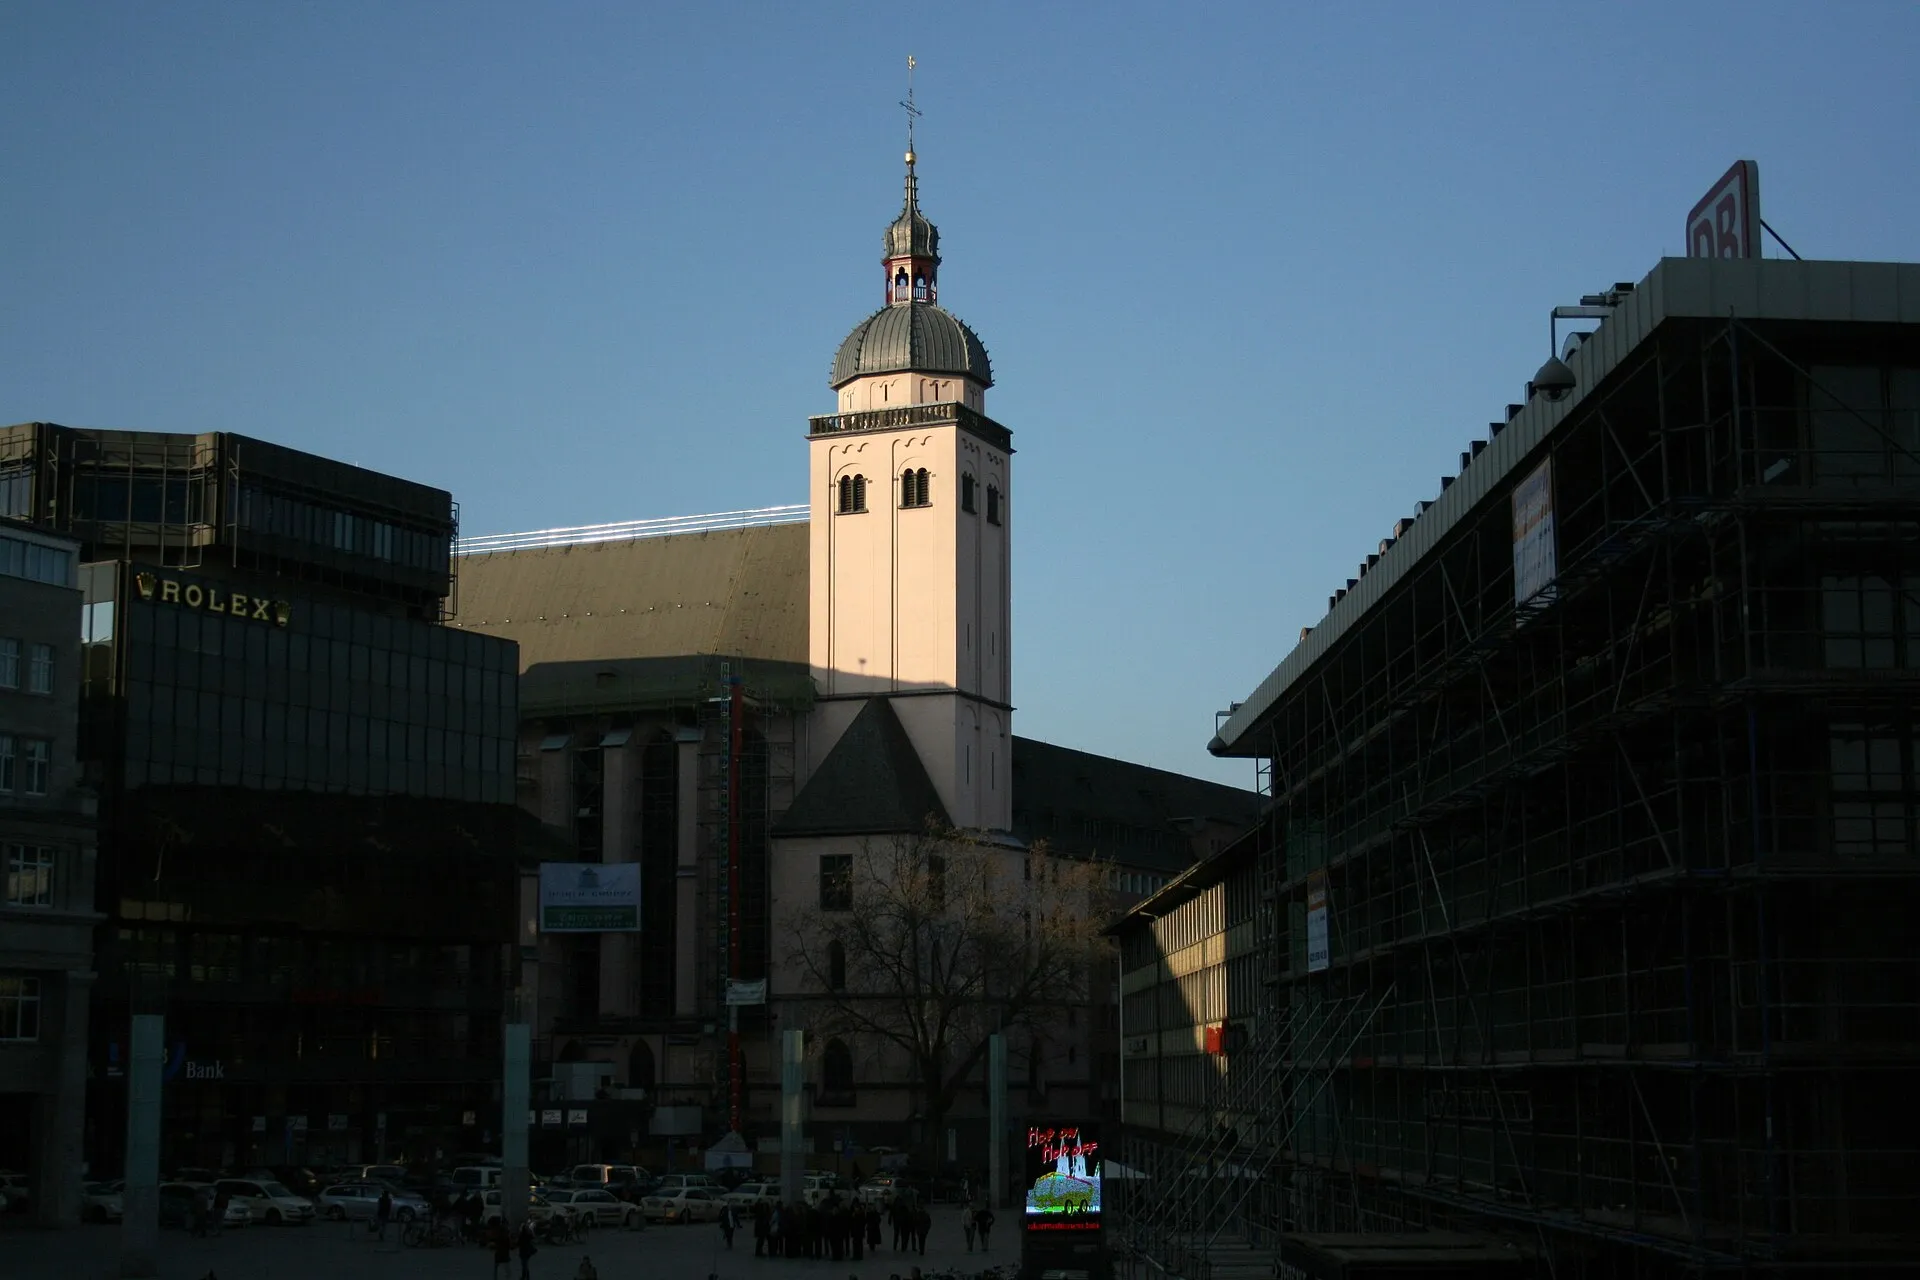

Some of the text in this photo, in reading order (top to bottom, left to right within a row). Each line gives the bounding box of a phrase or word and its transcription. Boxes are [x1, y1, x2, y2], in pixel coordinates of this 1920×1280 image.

[1693, 192, 1739, 259] DB
[161, 579, 270, 621] ROLEX
[185, 1060, 225, 1079] Bank
